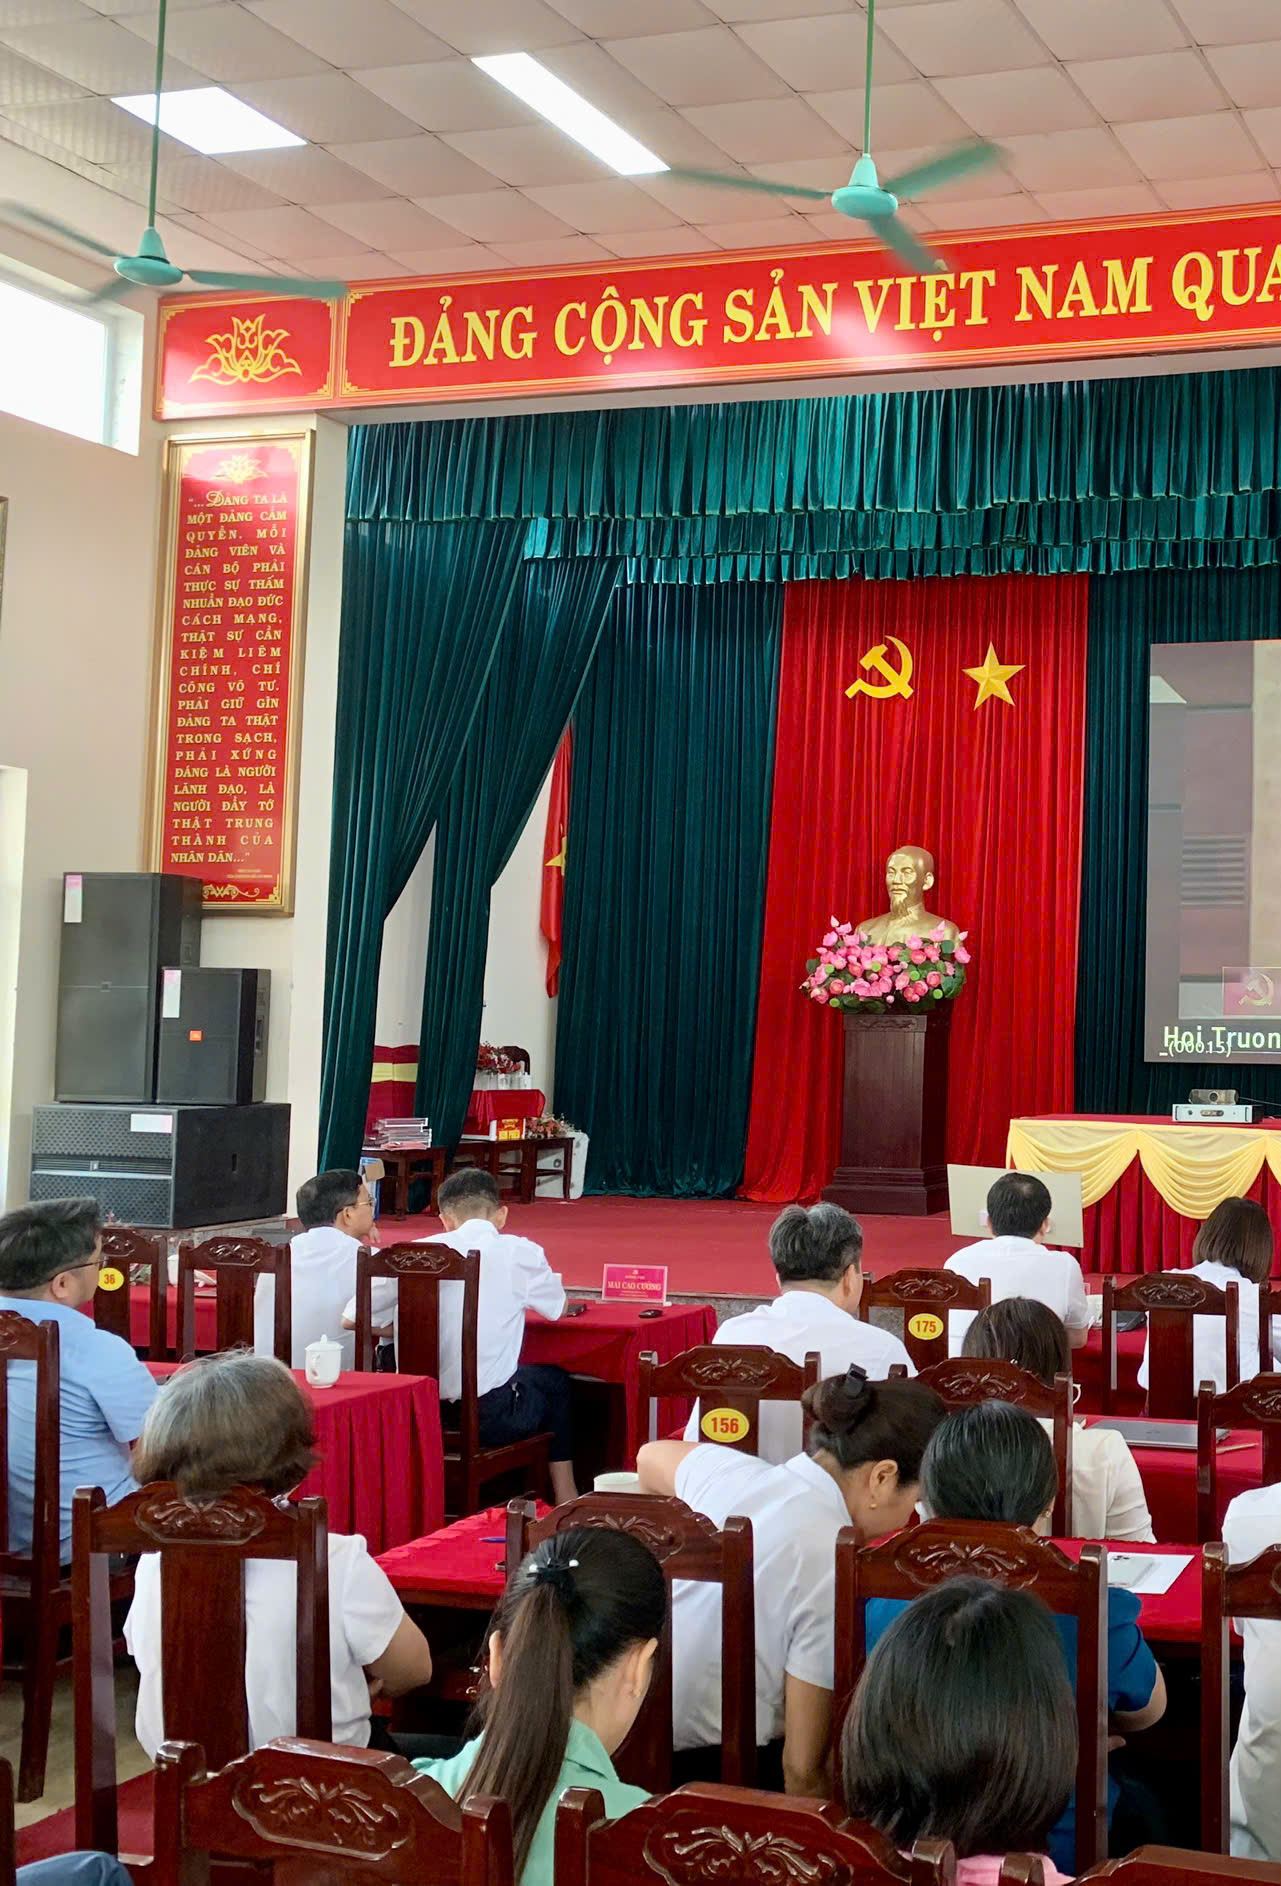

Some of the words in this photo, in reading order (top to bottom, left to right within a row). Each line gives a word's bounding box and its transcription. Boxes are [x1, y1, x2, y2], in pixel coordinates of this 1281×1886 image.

[389, 296, 538, 368] ĐẢNG
[554, 286, 708, 365] CỘNG
[723, 269, 838, 344] SẢN
[853, 260, 997, 342] VIỆT
[1014, 256, 1153, 321] NAM
[254, 495, 268, 504] TA
[187, 512, 213, 525] MỘT
[220, 509, 253, 522] ĐẢNG
[185, 545, 218, 558] ĐẢNG
[229, 544, 258, 556] VIÊN
[269, 543, 286, 555] VÀ
[184, 563, 210, 575] CÁN
[223, 561, 240, 575] BỘ
[253, 559, 285, 572] PHẢI
[184, 581, 216, 593] THỰC
[224, 579, 240, 592] SỰ
[248, 575, 284, 589] THẤM
[228, 597, 253, 608] ĐẠO
[257, 594, 284, 607] ĐỨC
[182, 613, 221, 626] CÁCH
[181, 630, 215, 643] THẬT
[227, 630, 244, 642] SỰ
[180, 647, 224, 660] KIỆM
[238, 645, 281, 657] LIÊM
[252, 662, 280, 675] CHÍ
[179, 680, 215, 693] CÔNG
[228, 680, 245, 692] VÔ
[178, 697, 209, 710] PHẢI
[221, 697, 245, 709] GIỮ
[256, 696, 279, 708] GÌN
[177, 713, 210, 727] ĐẢNG
[220, 716, 236, 726] TA
[246, 714, 278, 727] THẬT
[176, 733, 222, 743] TRONG
[176, 747, 216, 760] PHẢI
[231, 748, 276, 760] XỨNG
[175, 765, 208, 778] ĐÁNG
[215, 765, 231, 777] LÀ
[238, 764, 276, 777] NGƯỜI
[174, 782, 207, 794] LÃNH
[259, 781, 275, 794] LÀ
[173, 799, 211, 811] NGƯỜI
[222, 795, 248, 811] ĐẦY
[258, 799, 275, 811] TỚ
[172, 816, 212, 830] THẬT
[226, 818, 273, 828] TRUNG
[171, 833, 226, 845] THÀNH
[240, 832, 273, 845] CỦA
[171, 850, 204, 862] NHÂN
[915, 1319, 937, 1334] 175
[711, 1416, 739, 1434] 156
